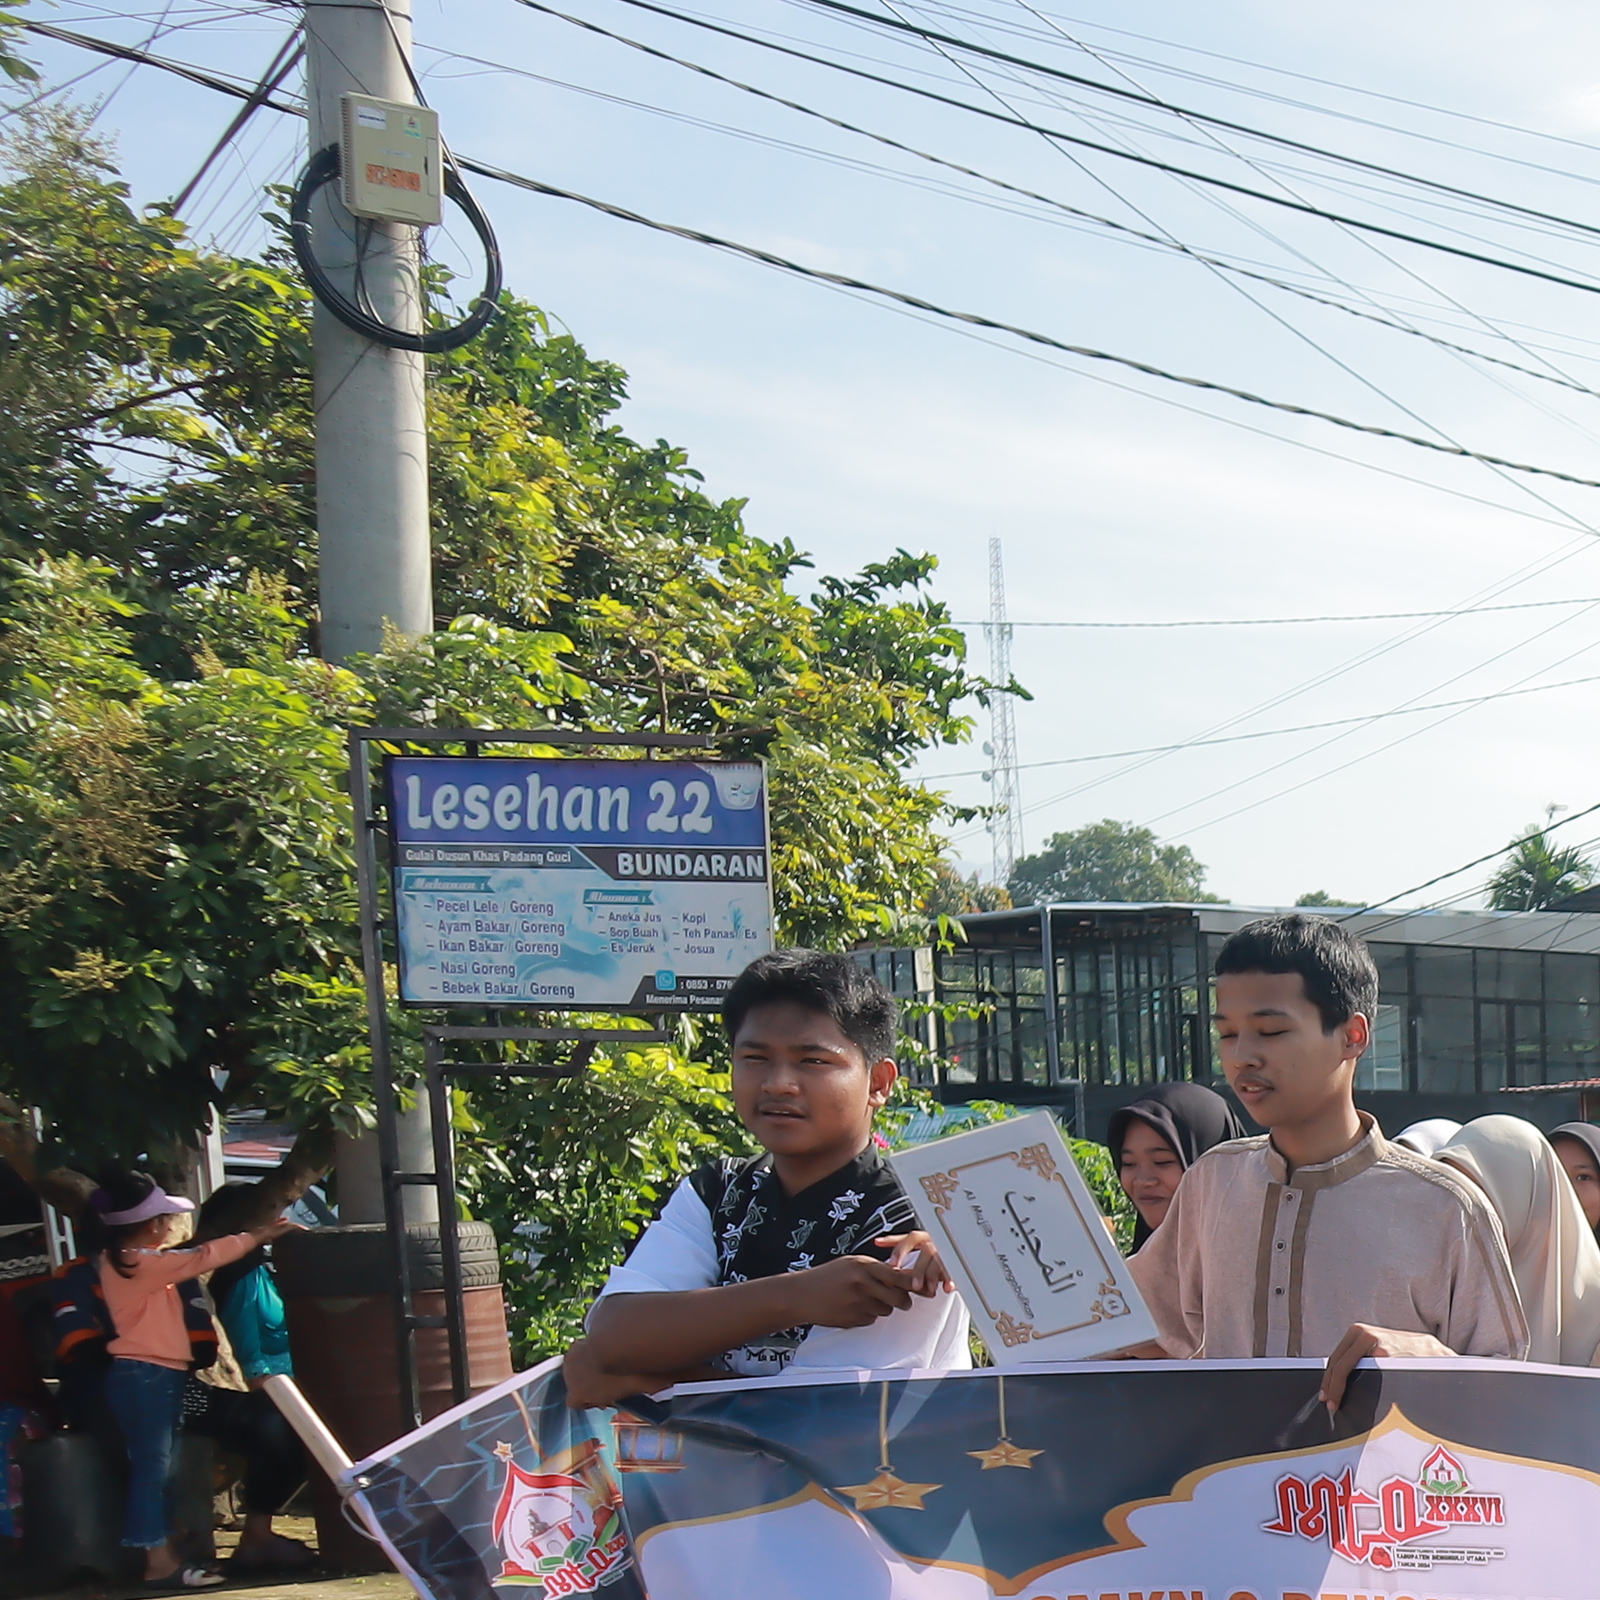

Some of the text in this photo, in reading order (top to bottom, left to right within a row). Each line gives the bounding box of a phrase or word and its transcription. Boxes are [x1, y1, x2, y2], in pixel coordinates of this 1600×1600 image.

[406, 772, 713, 834] Lesehan 22
[406, 850, 571, 865] Gulai Dusun Khas Padang Guci
[617, 853, 764, 878] BUNDARAN
[436, 899, 554, 916] Pecel Lele Goreng
[608, 912, 662, 922] Aneka Jus
[682, 913, 706, 925] Kopi
[438, 919, 565, 937] Ayam Bakar Goreng
[610, 928, 659, 939] Sop Buah
[683, 929, 701, 938] Teh
[744, 929, 757, 939] Es
[439, 939, 560, 956] Ikan Bakar Goreng
[611, 943, 655, 953] Es Jeruk
[684, 944, 715, 954] Josua
[441, 961, 516, 978] Nasi Goreng
[442, 981, 575, 998] Bebek Bakar Goreng
[1426, 1495, 1503, 1523] XXXVI
